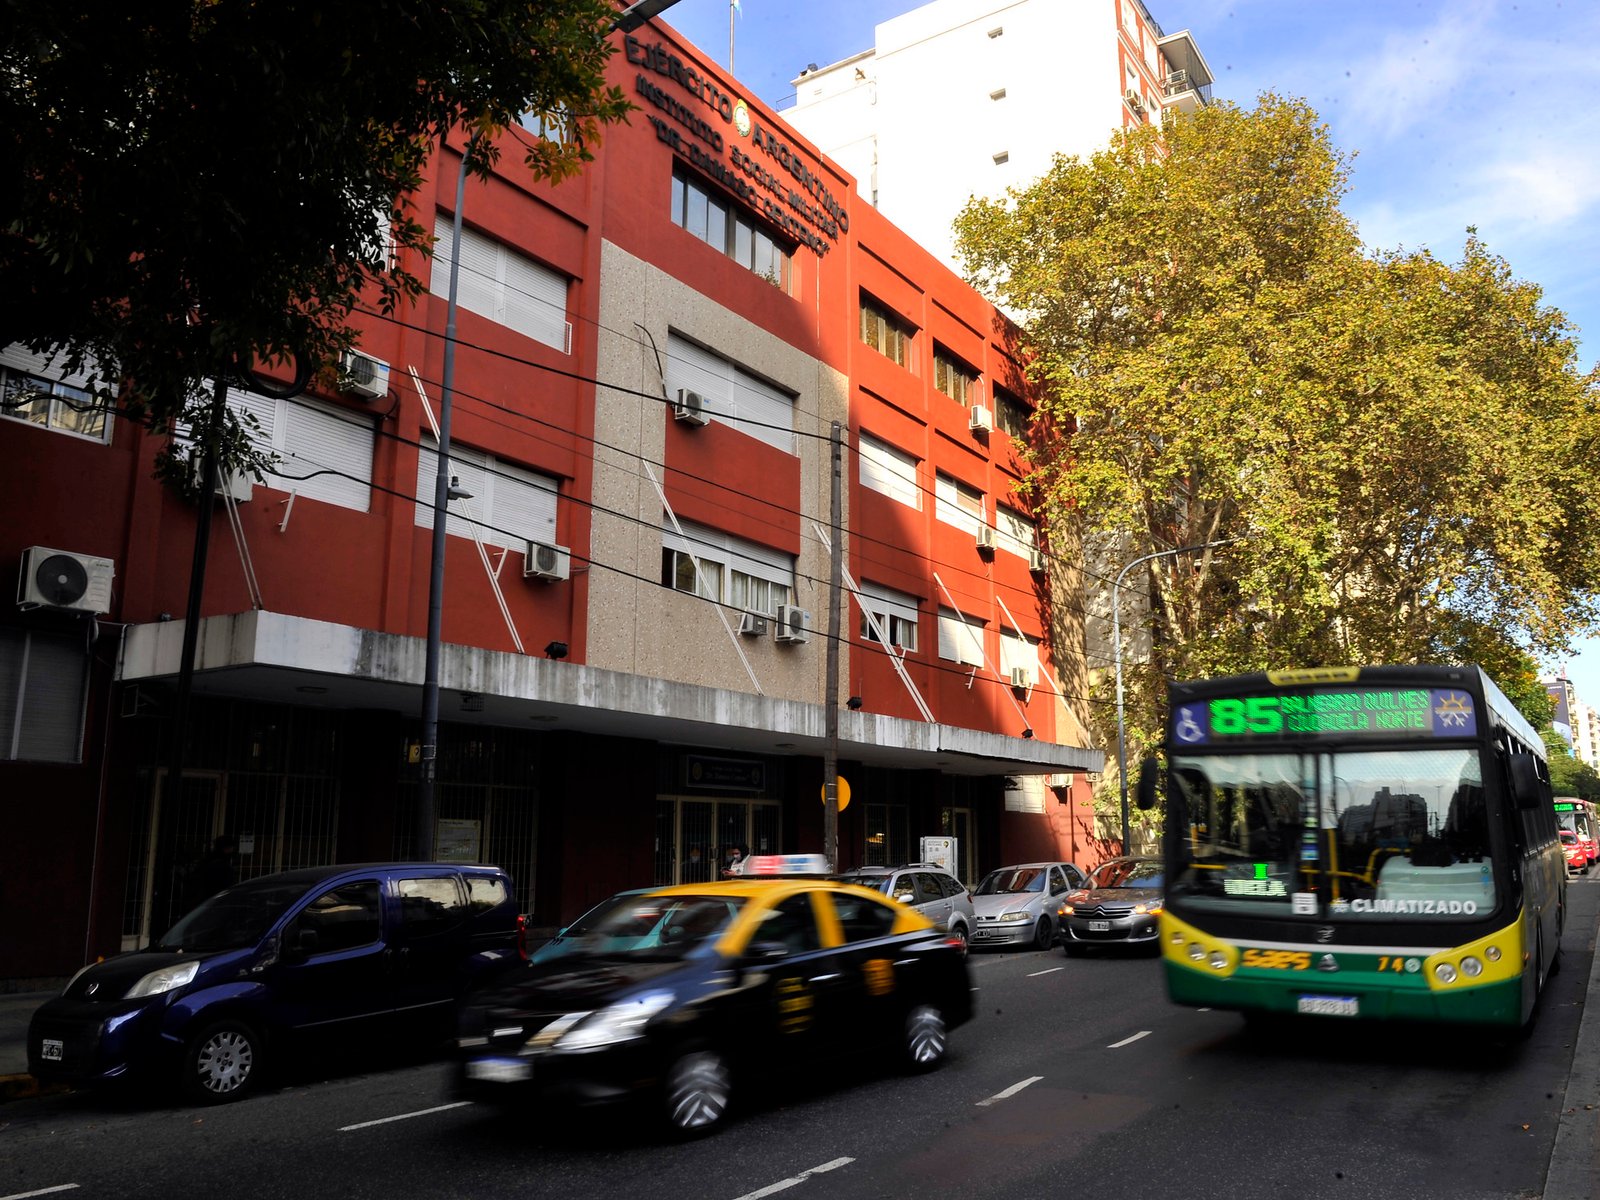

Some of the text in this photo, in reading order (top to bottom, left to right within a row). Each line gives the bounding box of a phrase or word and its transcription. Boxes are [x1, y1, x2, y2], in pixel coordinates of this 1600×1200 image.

[625, 34, 849, 234] EJÉRCITO ARGENTINO
[636, 73, 838, 240] INSTITUTO SOCIAL MILITAR
[1364, 690, 1429, 711] QUILMES
[1209, 697, 1283, 734] 85
[1376, 710, 1425, 729] NORTE
[1352, 898, 1477, 916] CLIMATIZADO
